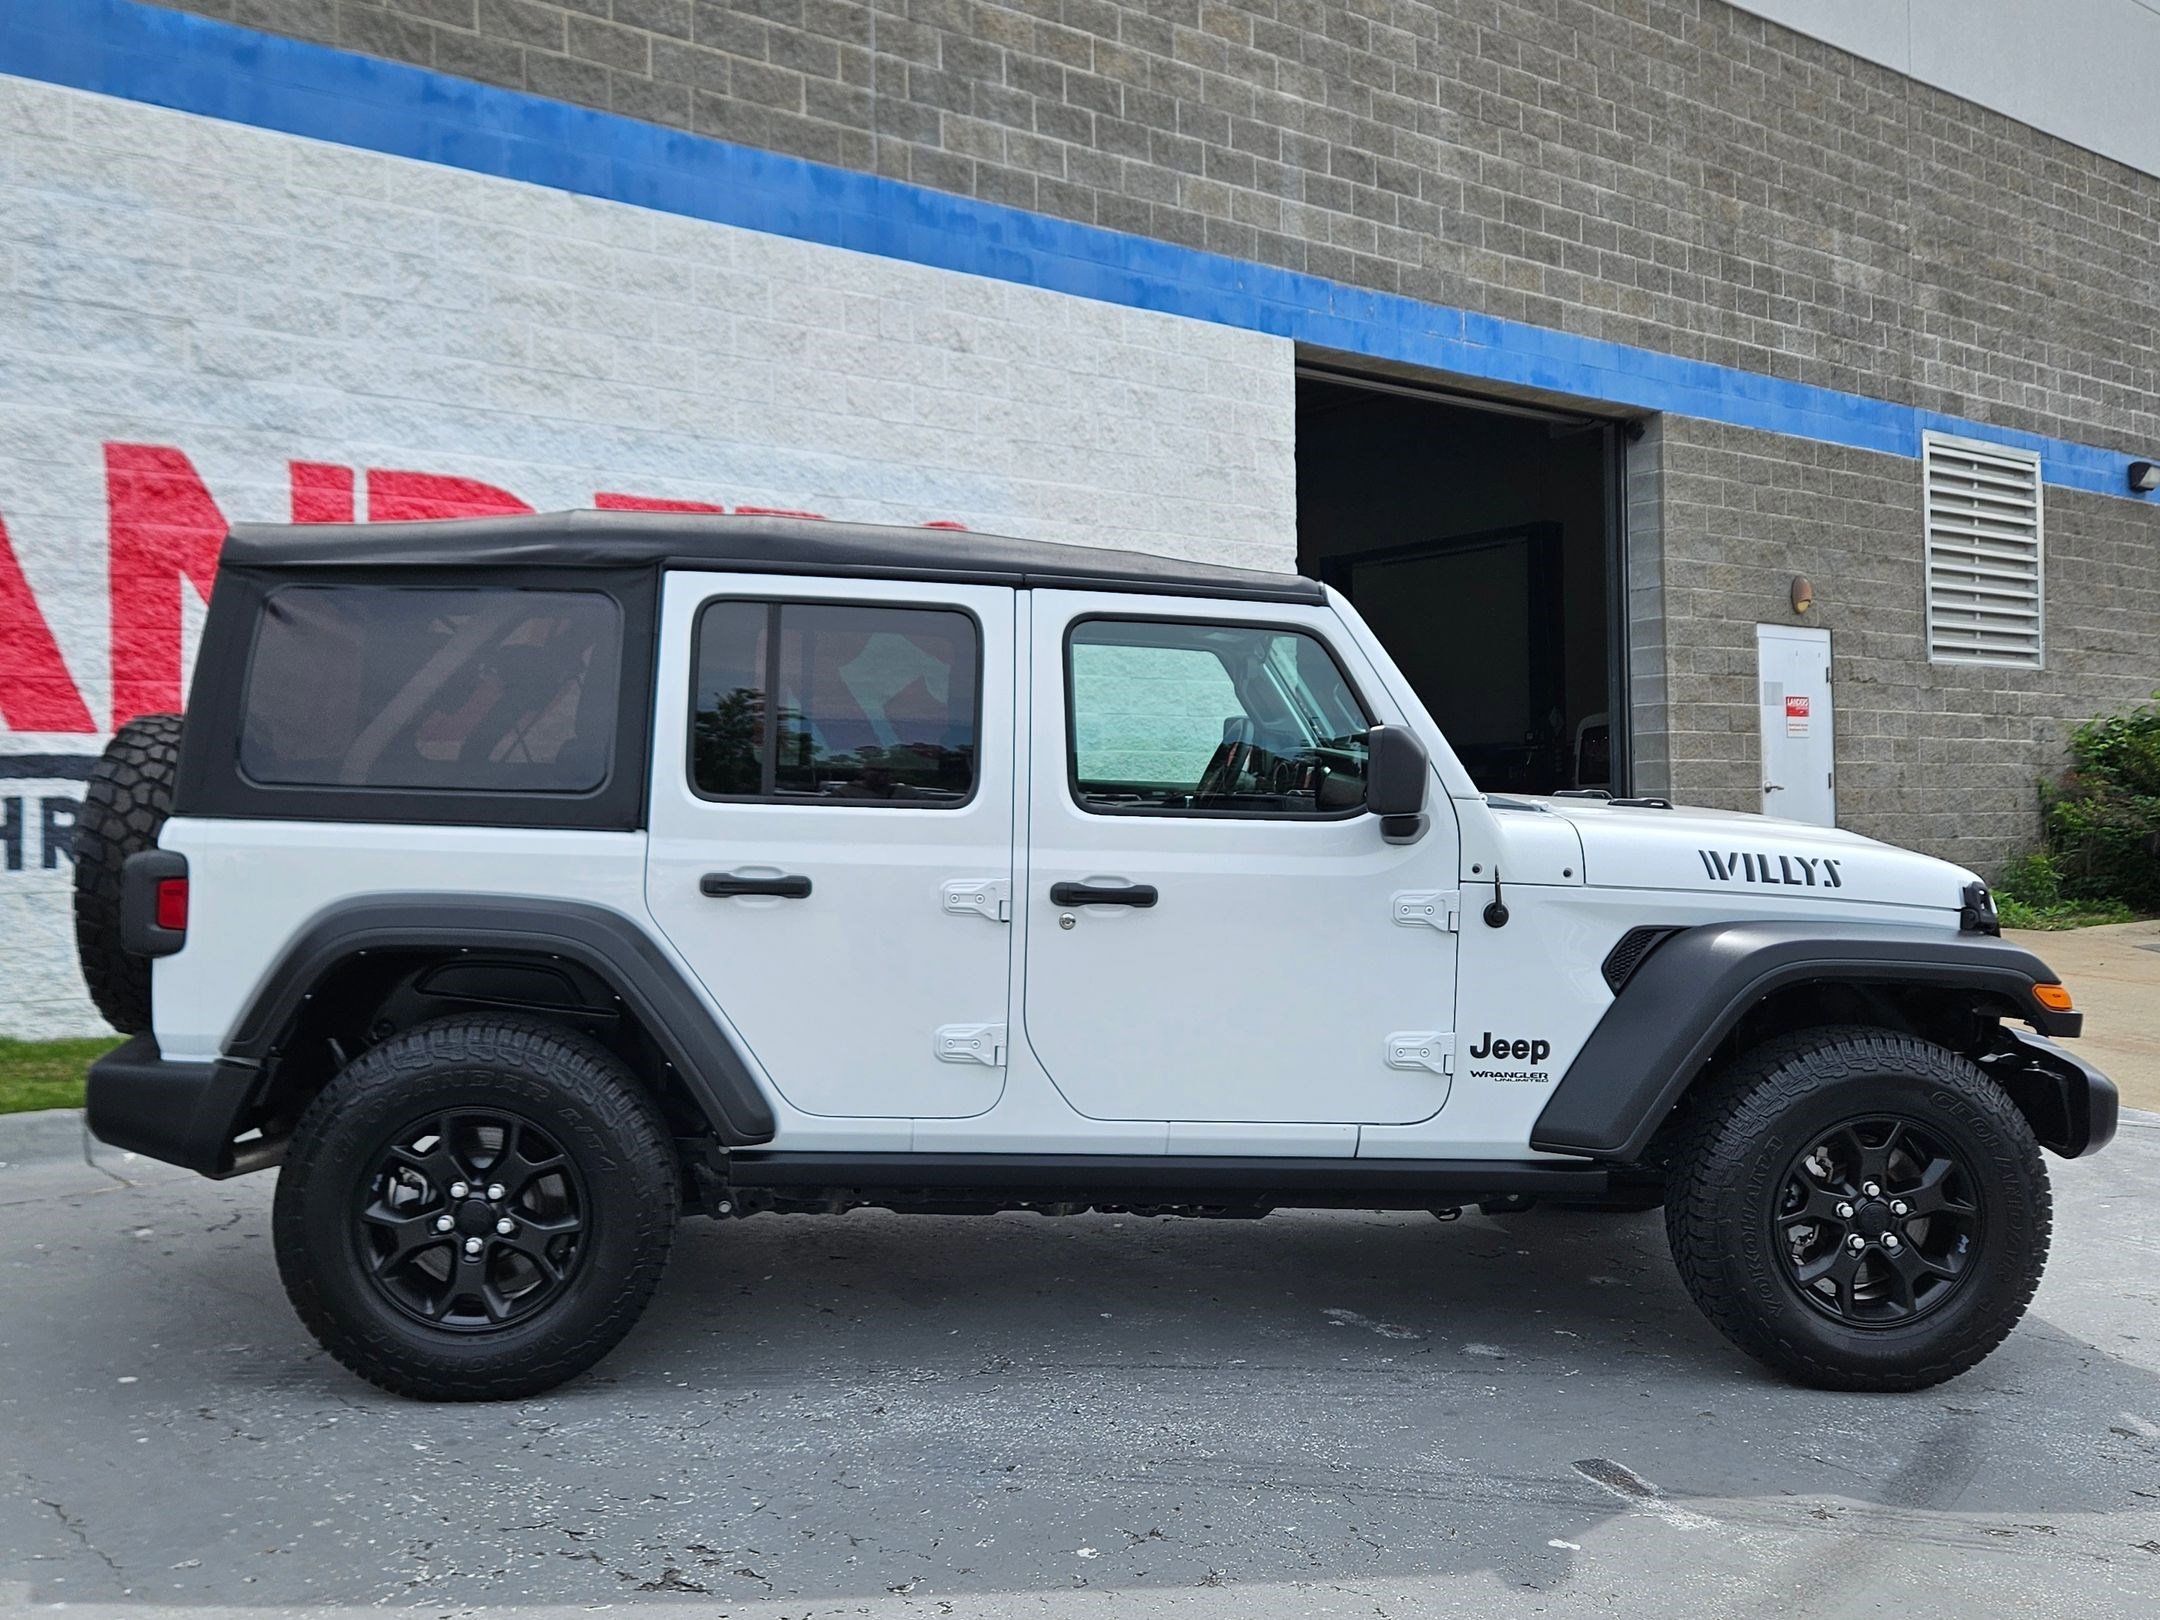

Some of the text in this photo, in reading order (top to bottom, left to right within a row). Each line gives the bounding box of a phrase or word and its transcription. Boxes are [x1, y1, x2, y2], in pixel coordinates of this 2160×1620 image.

[1697, 849, 1842, 888] WILLYS
[1469, 1031, 1551, 1066] Jeep
[1469, 1070, 1549, 1079] WRANGLER
